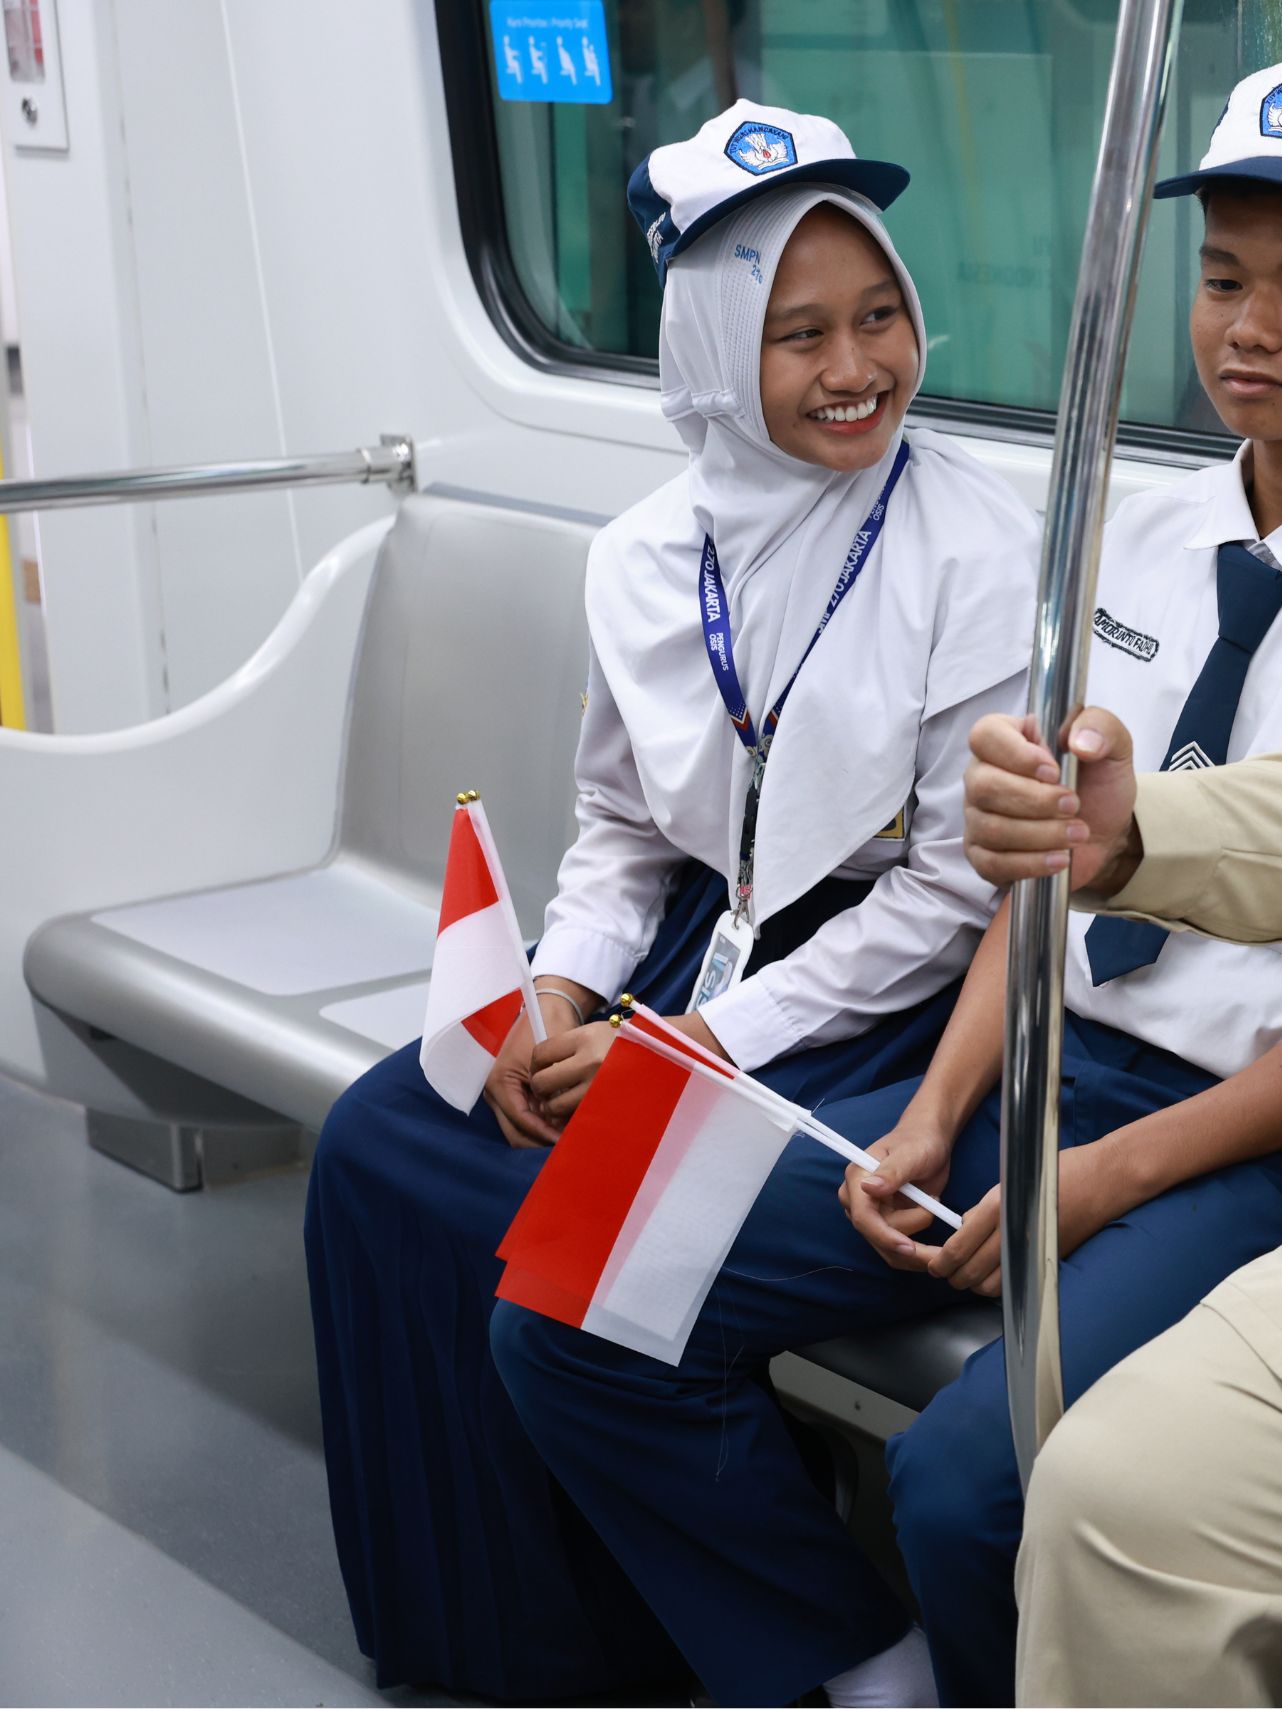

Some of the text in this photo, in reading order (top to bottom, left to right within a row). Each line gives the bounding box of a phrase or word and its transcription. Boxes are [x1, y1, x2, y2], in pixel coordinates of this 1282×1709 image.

[872, 504, 885, 521] OSIS
[840, 530, 872, 584] JAKARTA
[703, 570, 721, 623] JAKARTA
[709, 633, 718, 652] OSIS
[716, 632, 729, 671] PENGURUS
